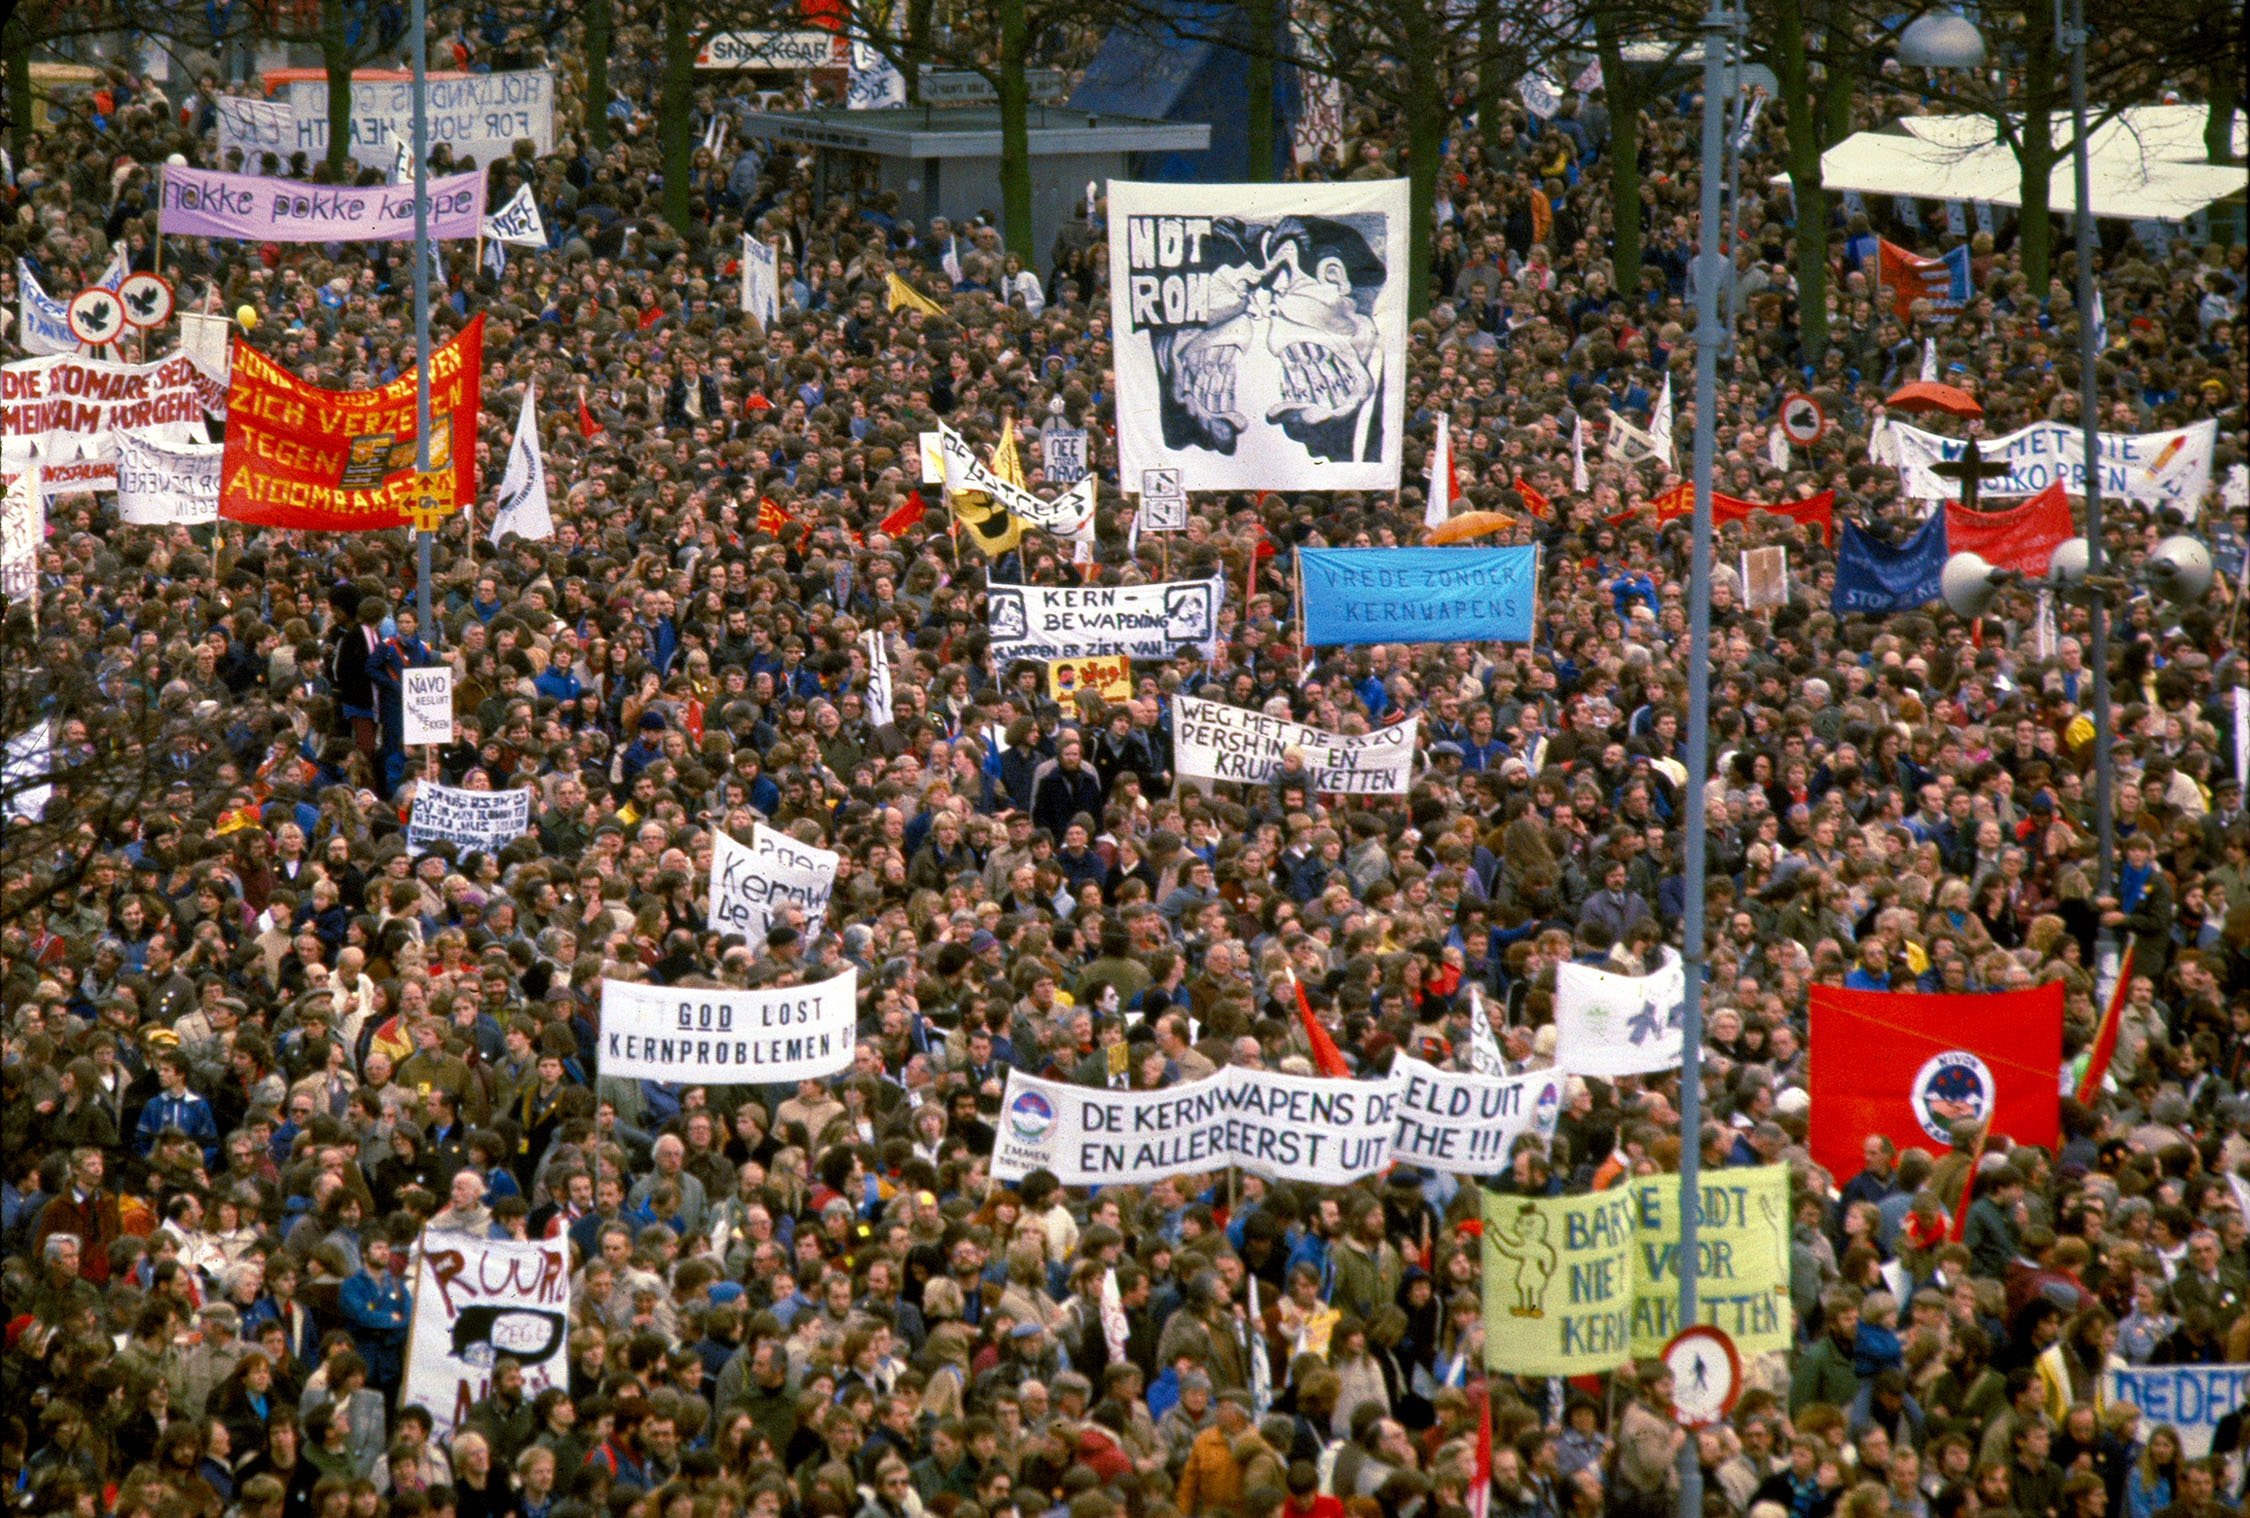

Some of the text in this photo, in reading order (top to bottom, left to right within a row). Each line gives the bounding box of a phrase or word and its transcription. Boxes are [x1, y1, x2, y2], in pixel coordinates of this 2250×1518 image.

[1130, 216, 1212, 270] NOT
[1, 369, 42, 400] DIE
[239, 424, 341, 476] TEGEN
[1324, 566, 1517, 588] VREDE ZONDER
[1345, 598, 1516, 623] KERNWAPENS
[1130, 641, 1163, 656] VAN
[408, 676, 445, 694] NAVO
[1180, 698, 1231, 725] WEG
[1243, 711, 1290, 739] MET
[1299, 728, 1329, 748] DE
[1181, 722, 1359, 769] PERSHIN EN
[678, 997, 822, 1029] GOD LOST
[609, 1032, 831, 1065] KERNPROBLEMEN
[1081, 1101, 1123, 1133] DE
[1134, 1083, 1355, 1132] KERNWAPENS
[1404, 1075, 1470, 1117] ELD
[1480, 1082, 1525, 1119] UIT
[1080, 1142, 1126, 1172] EN
[1133, 1117, 1328, 1172] ALLEREERST
[1340, 1136, 1387, 1170] UIT
[1396, 1114, 1461, 1160] THE
